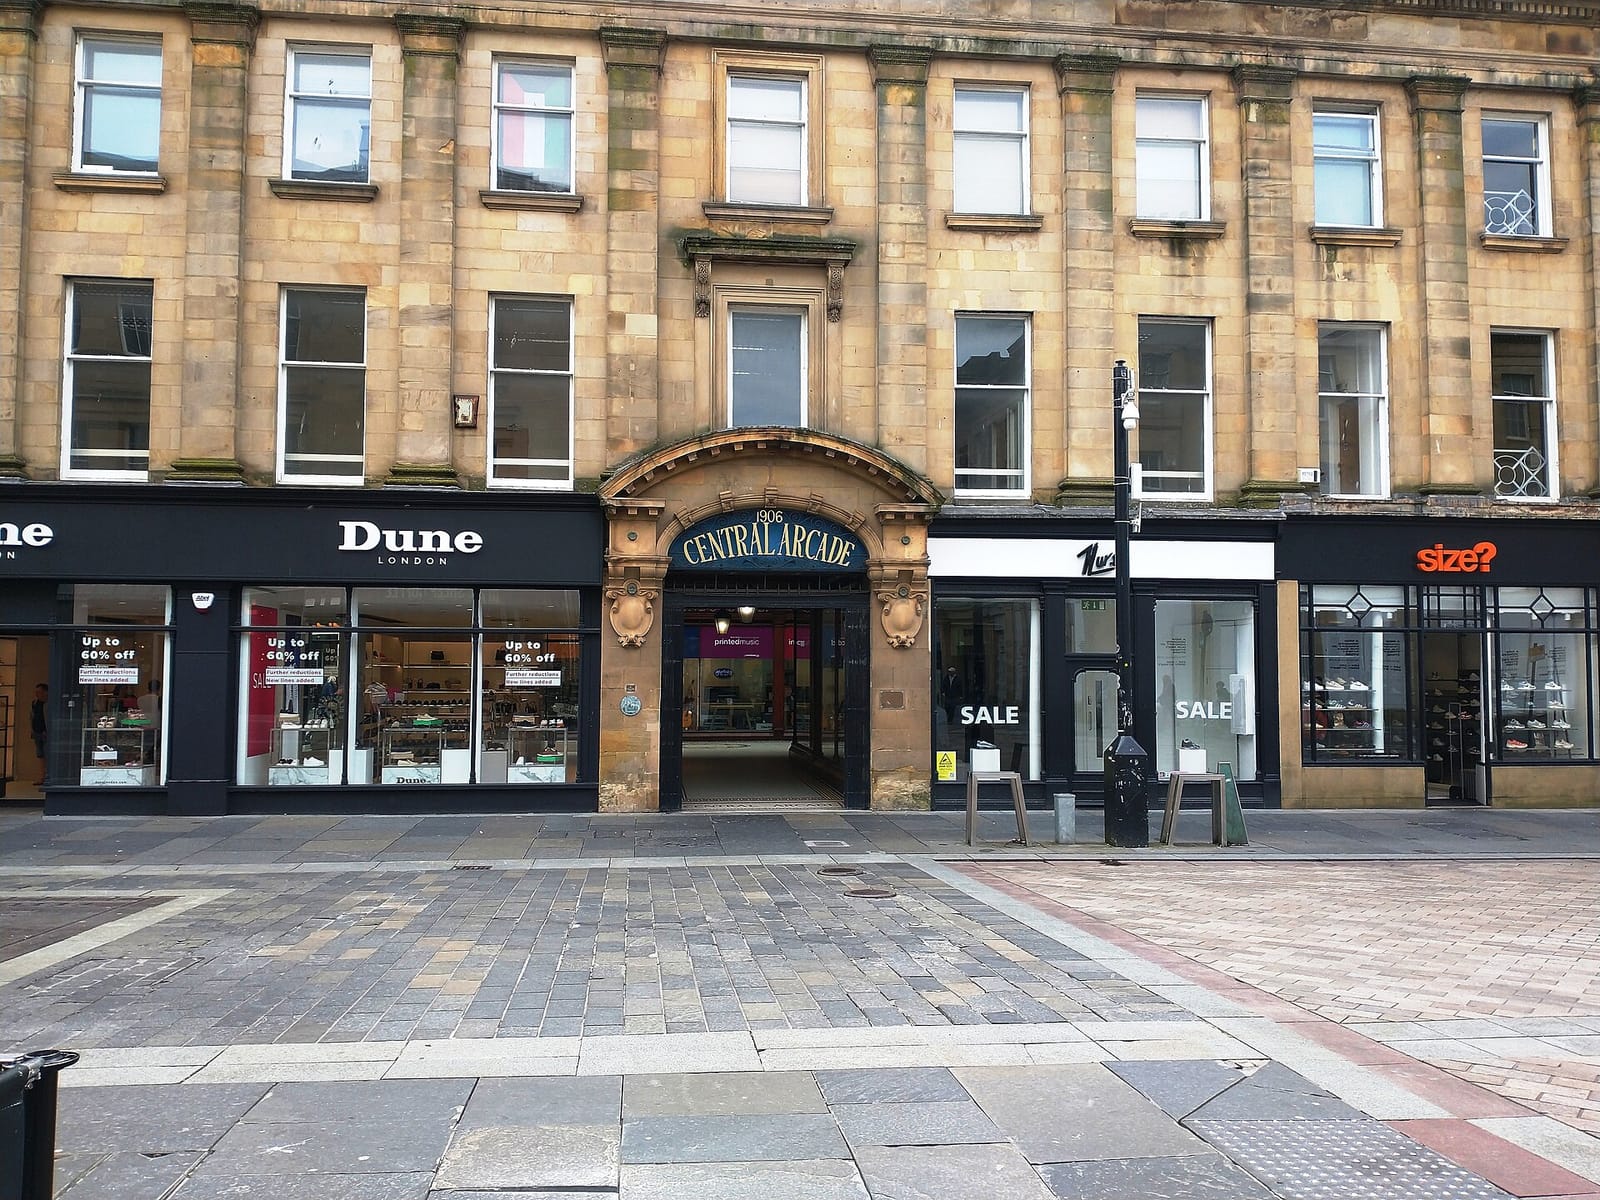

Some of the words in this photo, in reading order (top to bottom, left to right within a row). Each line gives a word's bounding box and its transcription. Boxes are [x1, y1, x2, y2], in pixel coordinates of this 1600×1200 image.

[756, 509, 783, 523] 1906
[0, 522, 54, 547] ne
[338, 520, 483, 553] Dune
[683, 522, 775, 565] CENTRAL
[778, 523, 856, 567] ARCADE
[378, 556, 448, 566] LONDON
[1416, 542, 1497, 573] size?
[82, 637, 101, 648] Up
[105, 637, 120, 646] to
[268, 638, 286, 649] Up
[290, 638, 305, 647] to
[505, 640, 523, 652] Up
[527, 641, 541, 650] to
[714, 638, 760, 647] printedmusic
[81, 650, 110, 660] 60%
[114, 650, 136, 660] off
[266, 651, 295, 662] 60%
[300, 651, 320, 661] off
[504, 653, 532, 663] 60%
[535, 653, 556, 663] off
[252, 672, 272, 689] SAL
[960, 705, 1020, 726] SALE
[1175, 700, 1233, 721] SALE
